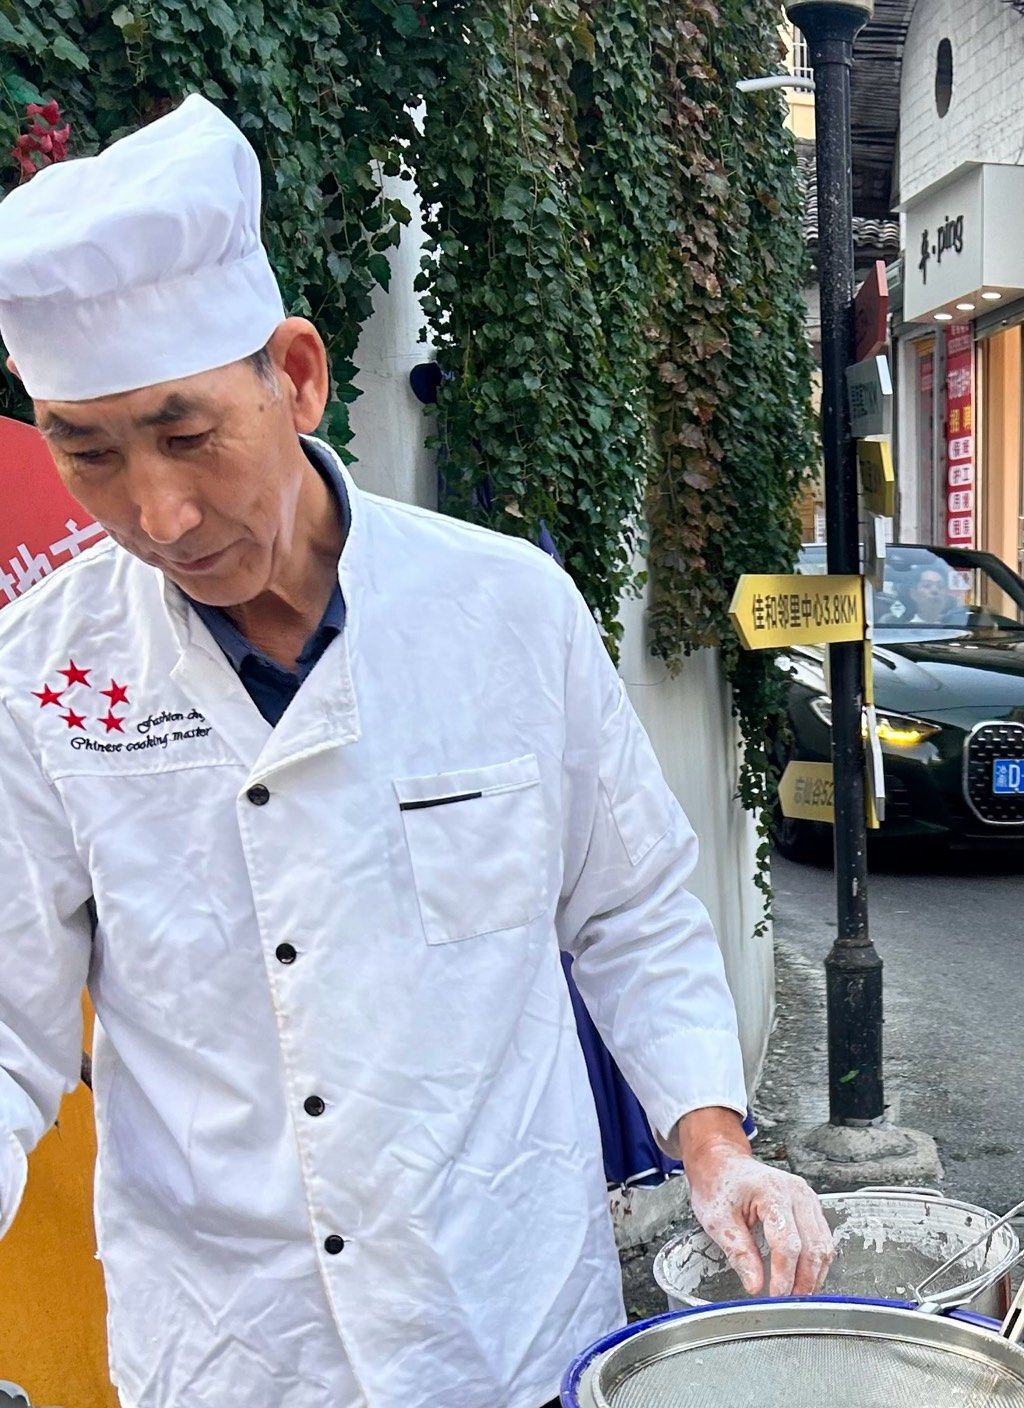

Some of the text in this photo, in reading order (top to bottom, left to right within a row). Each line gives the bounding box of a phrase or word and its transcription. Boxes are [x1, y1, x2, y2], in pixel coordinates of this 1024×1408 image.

[752, 592, 858, 631] 佳和邻里中心3.8KM
[70, 737, 123, 753] Chinese
